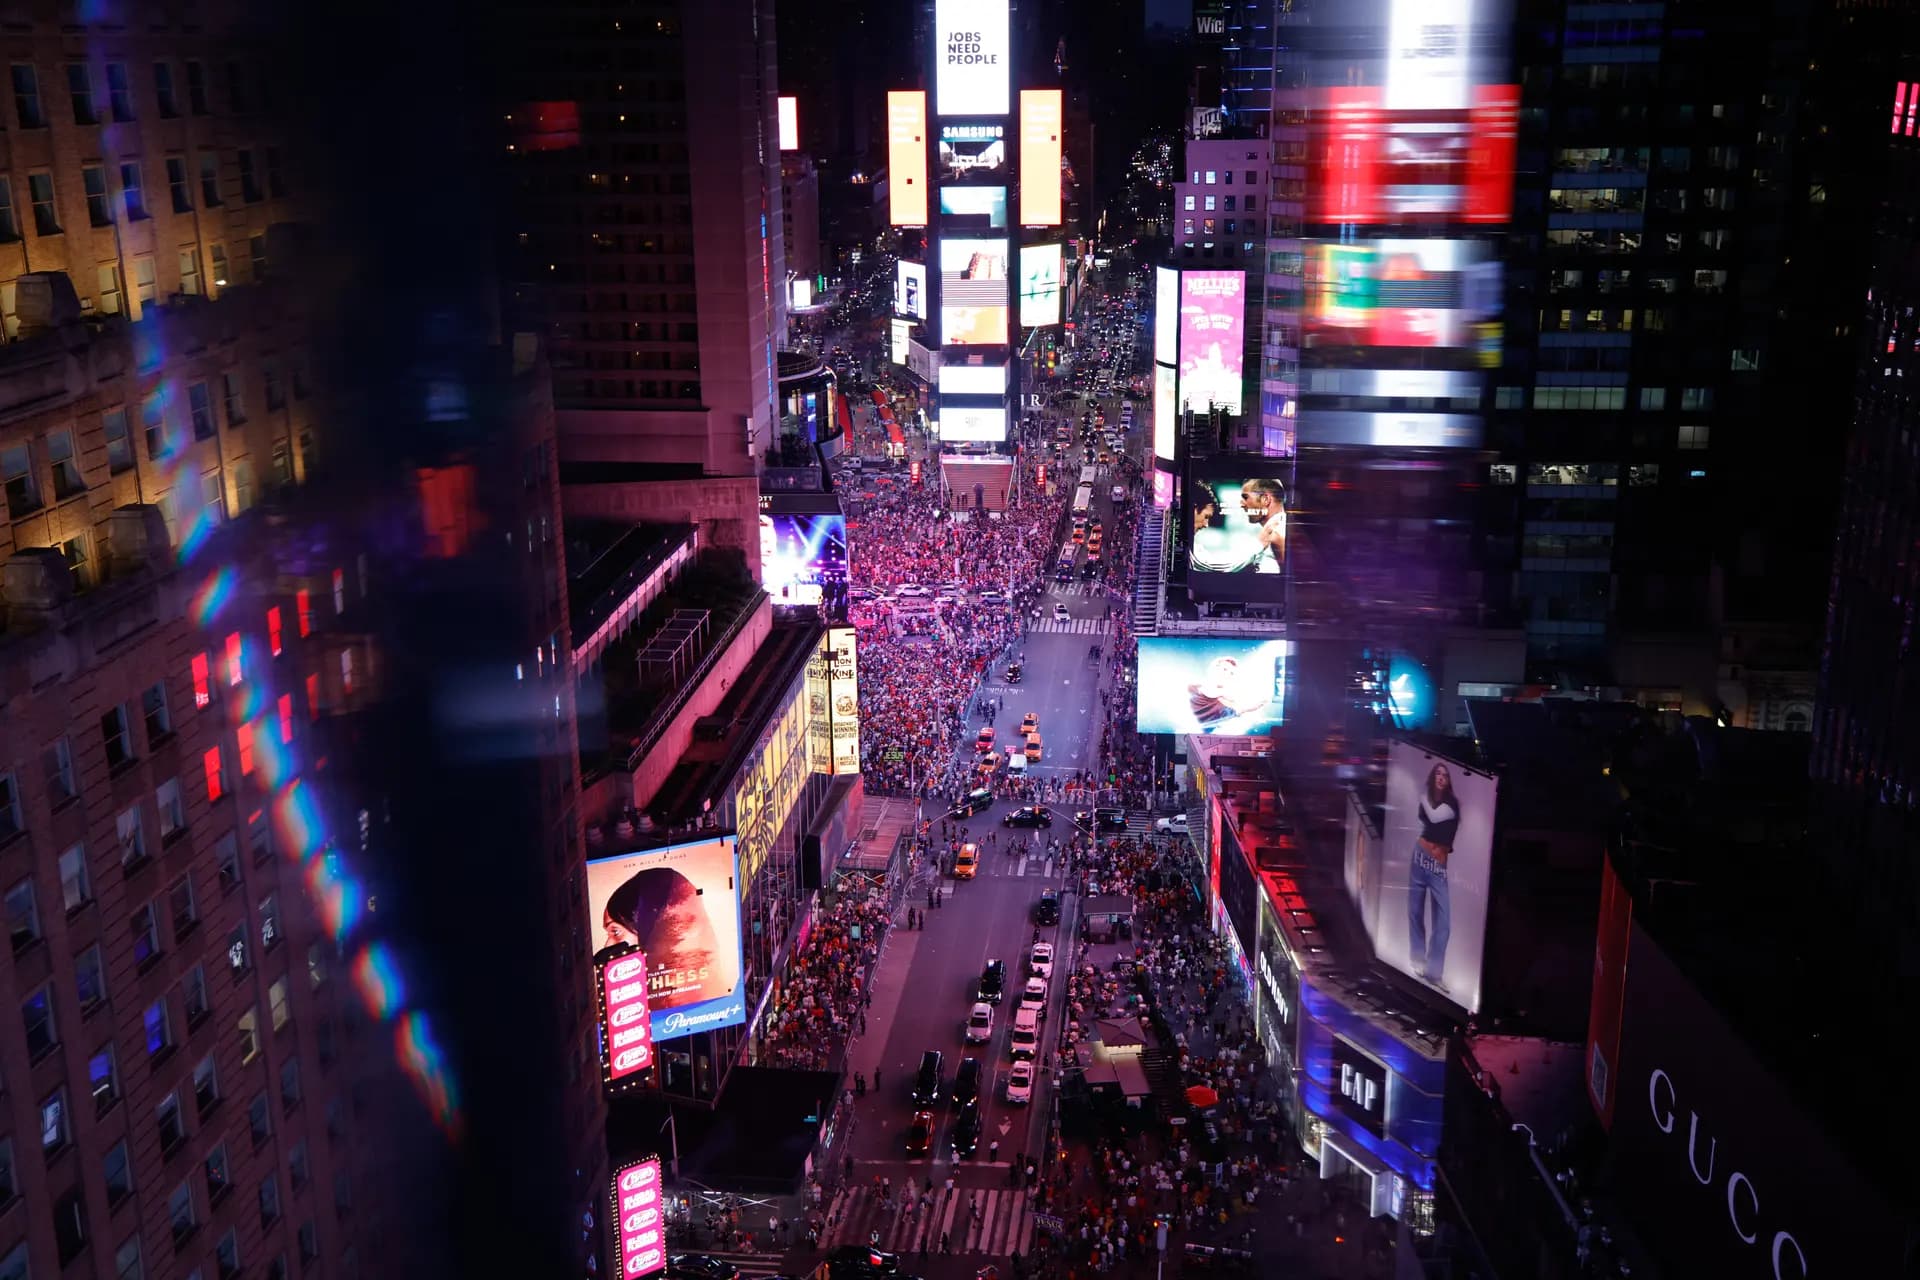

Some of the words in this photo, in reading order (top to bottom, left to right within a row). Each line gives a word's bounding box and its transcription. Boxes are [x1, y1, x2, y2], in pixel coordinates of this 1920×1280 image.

[948, 32, 982, 43] JOBS
[948, 43, 981, 54] NEED
[948, 54, 998, 65] PEOPLE
[943, 126, 1004, 139] SAMSUNG
[1260, 951, 1272, 988] OLD
[1270, 975, 1289, 1025] NAVY
[663, 1003, 743, 1034] Paramount+
[1341, 1063, 1378, 1112] GAP
